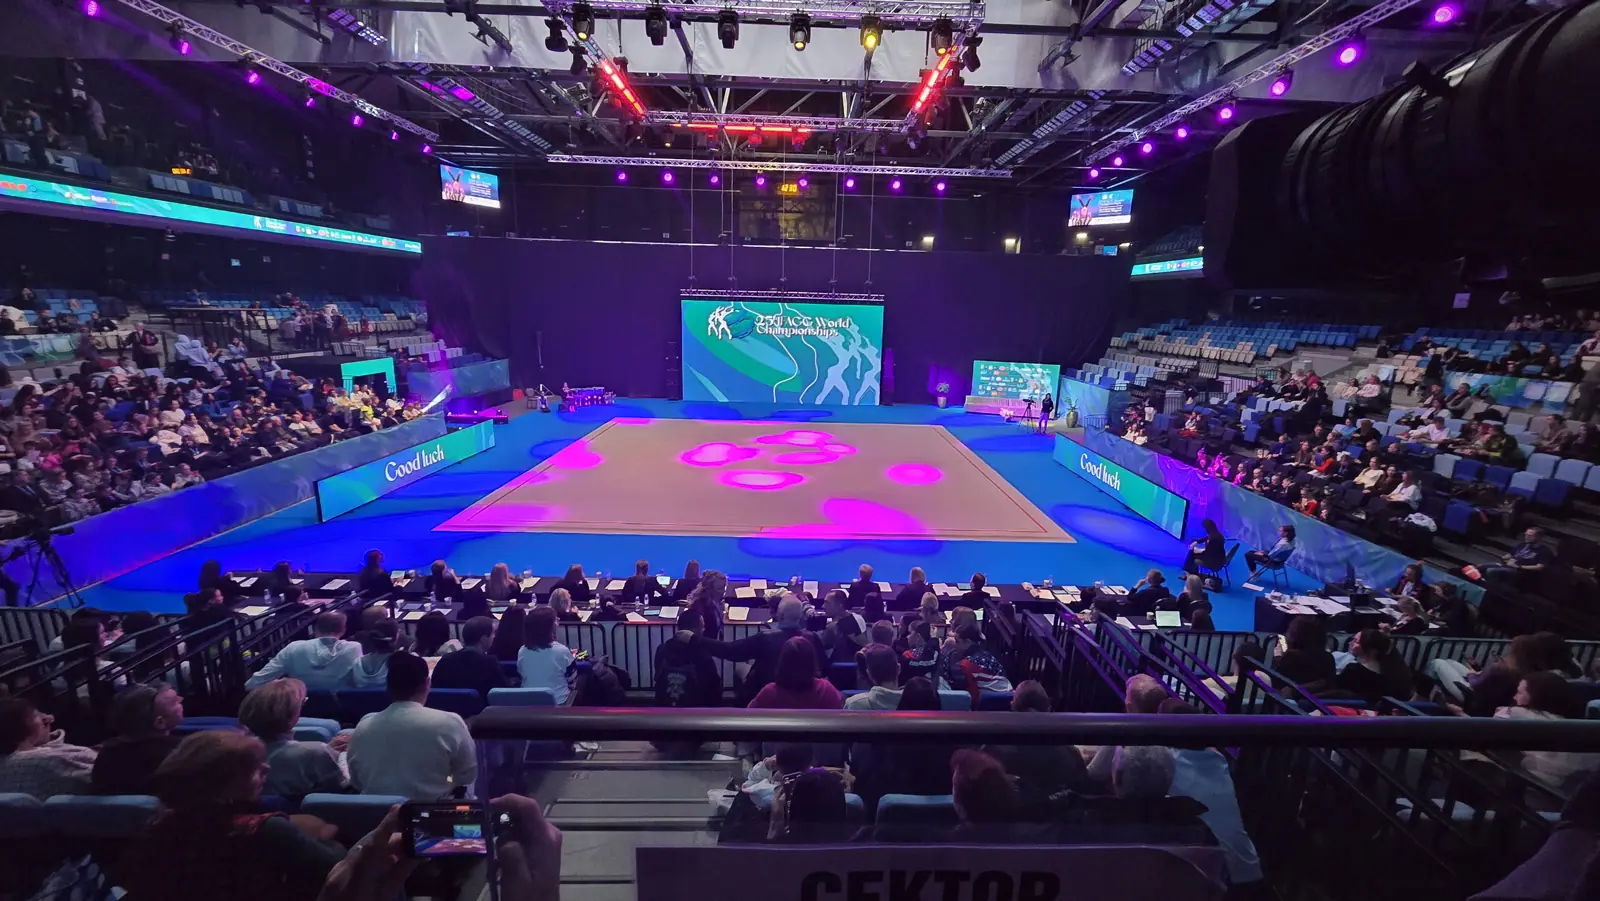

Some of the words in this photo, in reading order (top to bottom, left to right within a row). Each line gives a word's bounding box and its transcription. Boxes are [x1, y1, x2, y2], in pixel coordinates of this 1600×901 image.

[756, 325, 838, 338] Championships
[815, 317, 850, 328] World
[385, 452, 420, 481] Good
[422, 444, 444, 467] luck
[1080, 453, 1102, 479] Good
